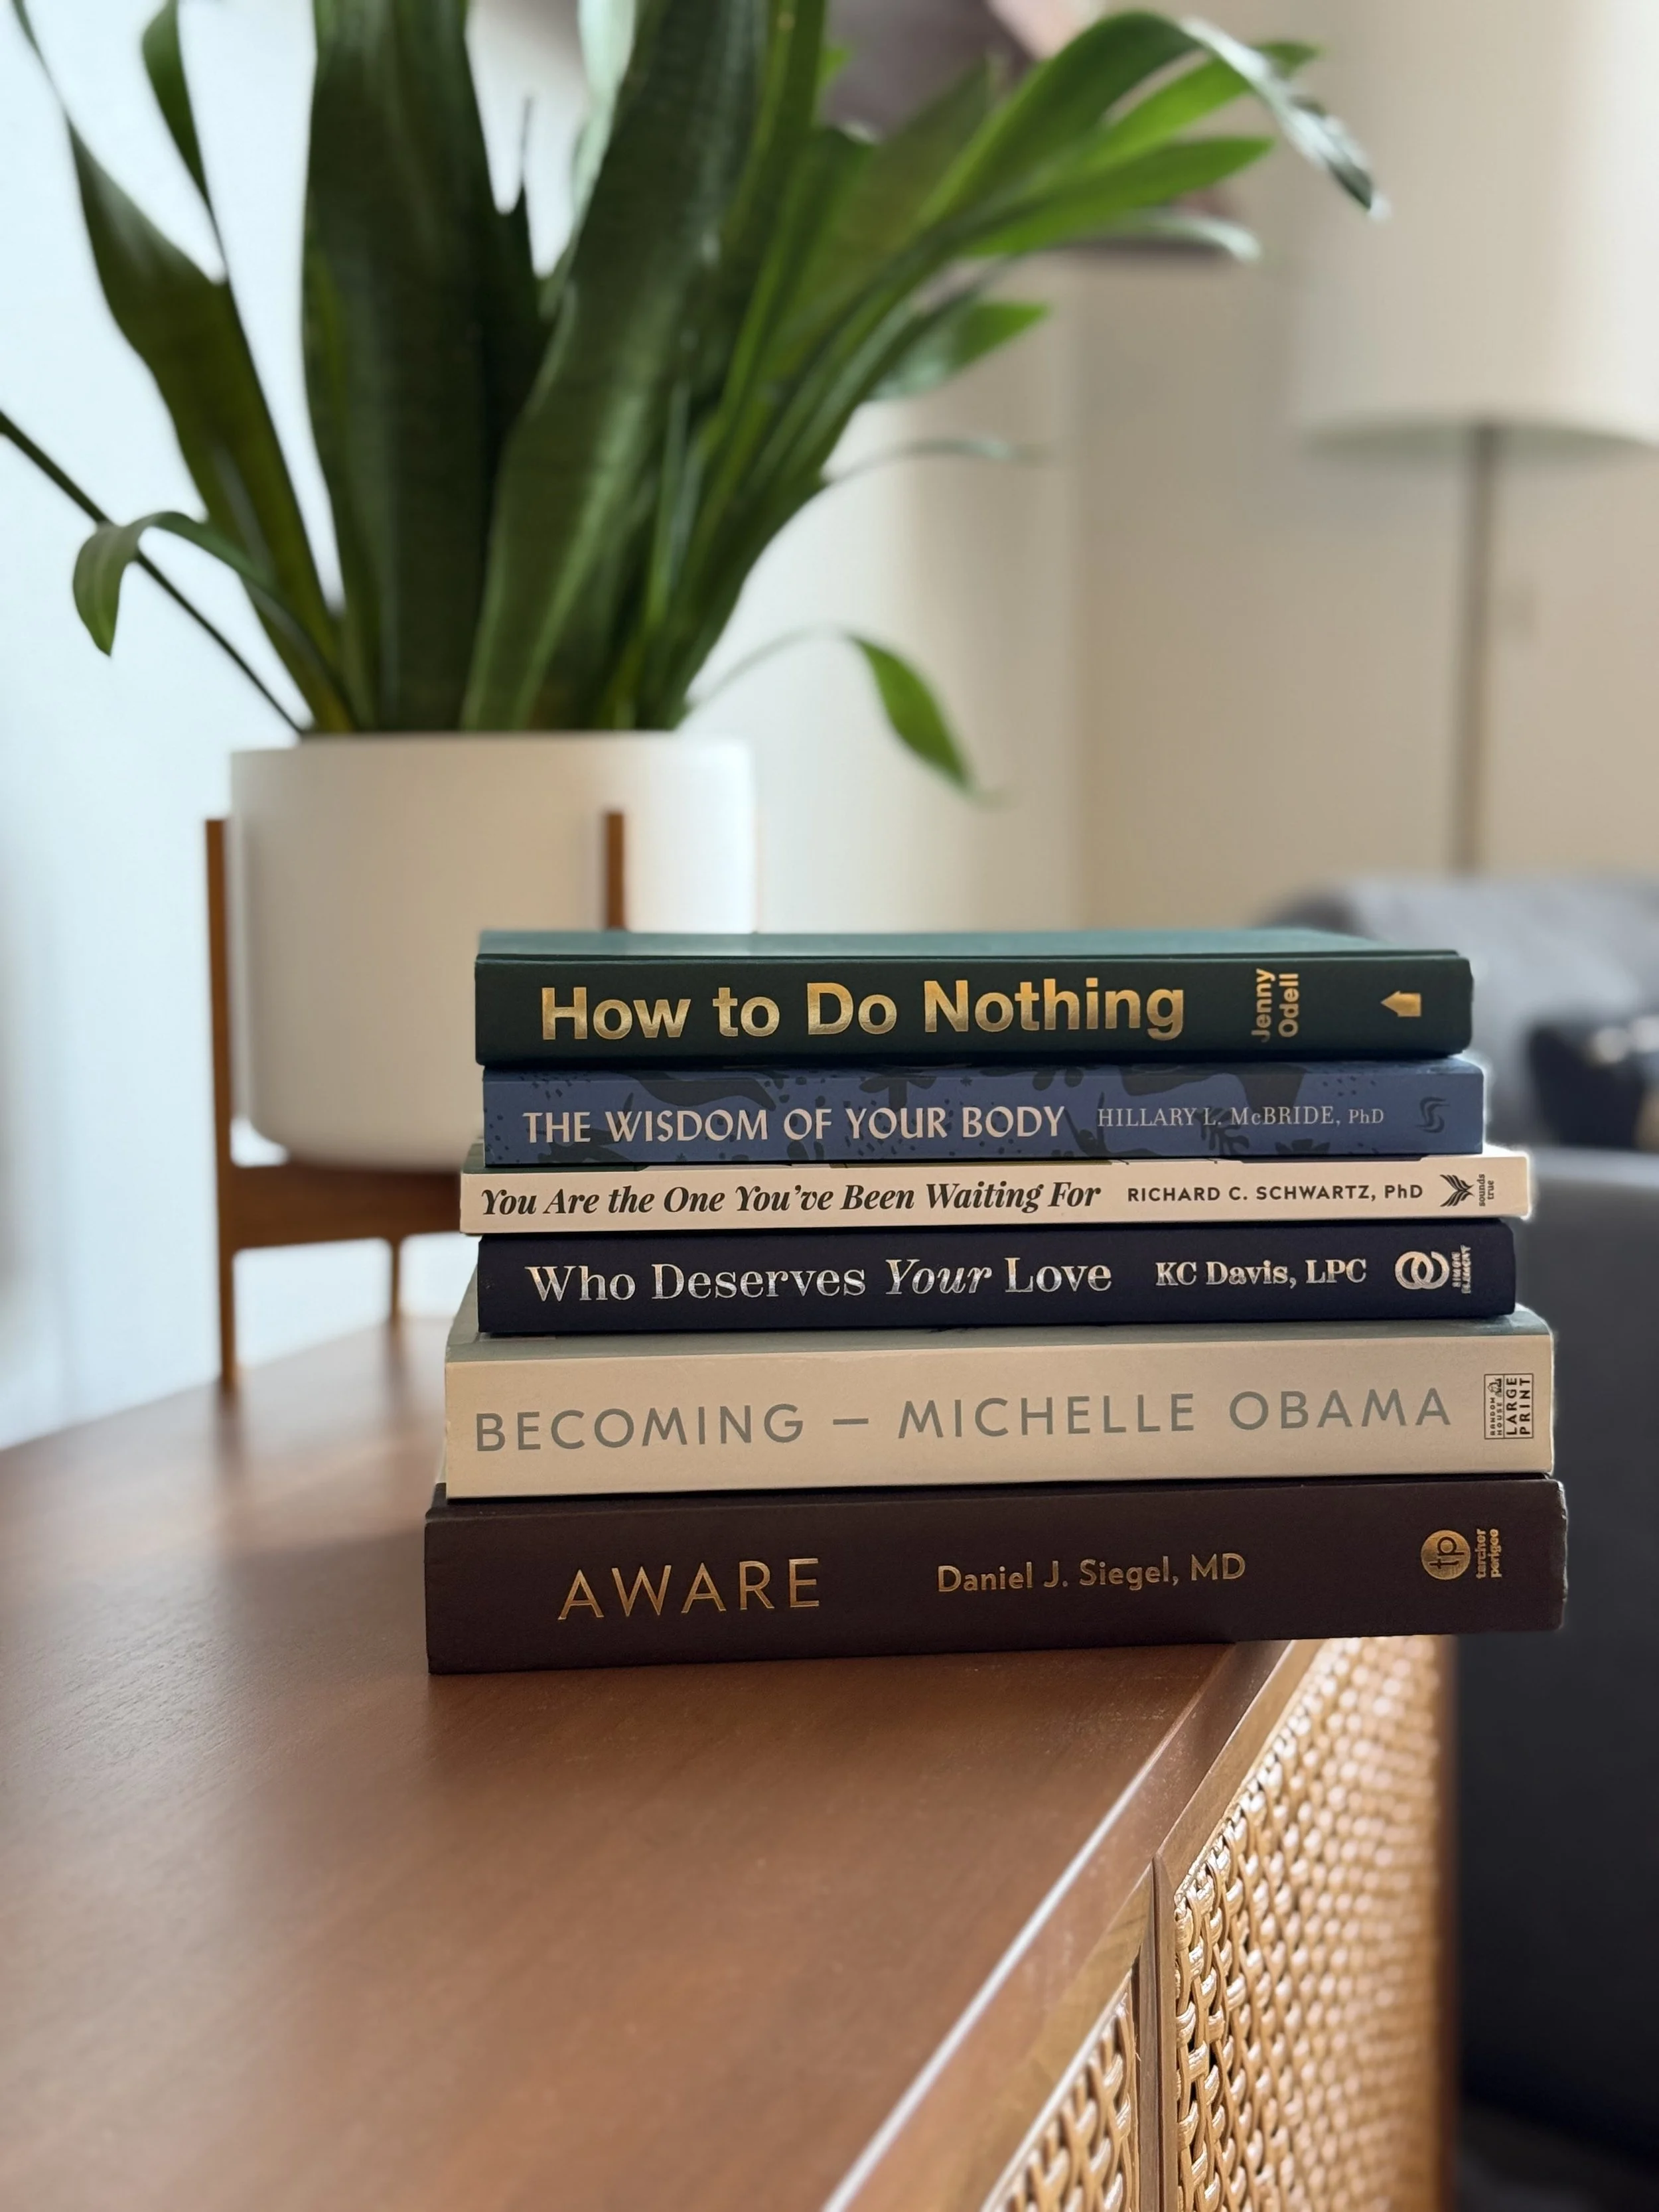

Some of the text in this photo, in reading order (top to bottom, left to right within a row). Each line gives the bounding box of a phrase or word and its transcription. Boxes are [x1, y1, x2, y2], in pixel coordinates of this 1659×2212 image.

[542, 978, 1184, 1041] How to Do Nothing
[1251, 968, 1275, 1043] Jenny
[1278, 974, 1299, 1038] Odell
[523, 1106, 1064, 1143] THE WISDOM OF YOUR BODY
[1098, 1106, 1384, 1126] HILLARY L. McBRIDE, PhD
[482, 1181, 1102, 1215] You Are the One You’ve Been Waiting For
[1128, 1185, 1422, 1201] RICHARD C. SCHWARTZ, PhD
[1477, 1174, 1485, 1207] sounds
[525, 1258, 1111, 1301] Who Deserves Your Love
[1156, 1259, 1366, 1288] KC Davis, LPC
[1451, 1252, 1461, 1288] SIMON
[476, 1404, 803, 1451] BECOMING
[899, 1394, 1194, 1438] MICHELLE
[1230, 1388, 1451, 1430] OBAMA
[1506, 1378, 1517, 1435] LARGE
[1520, 1378, 1530, 1434] PRINT
[938, 1553, 1245, 1591] Daniel J. Siegel, MD
[1475, 1529, 1486, 1578] tarcher
[1488, 1529, 1502, 1578] perigee
[558, 1558, 819, 1620] AWARE
